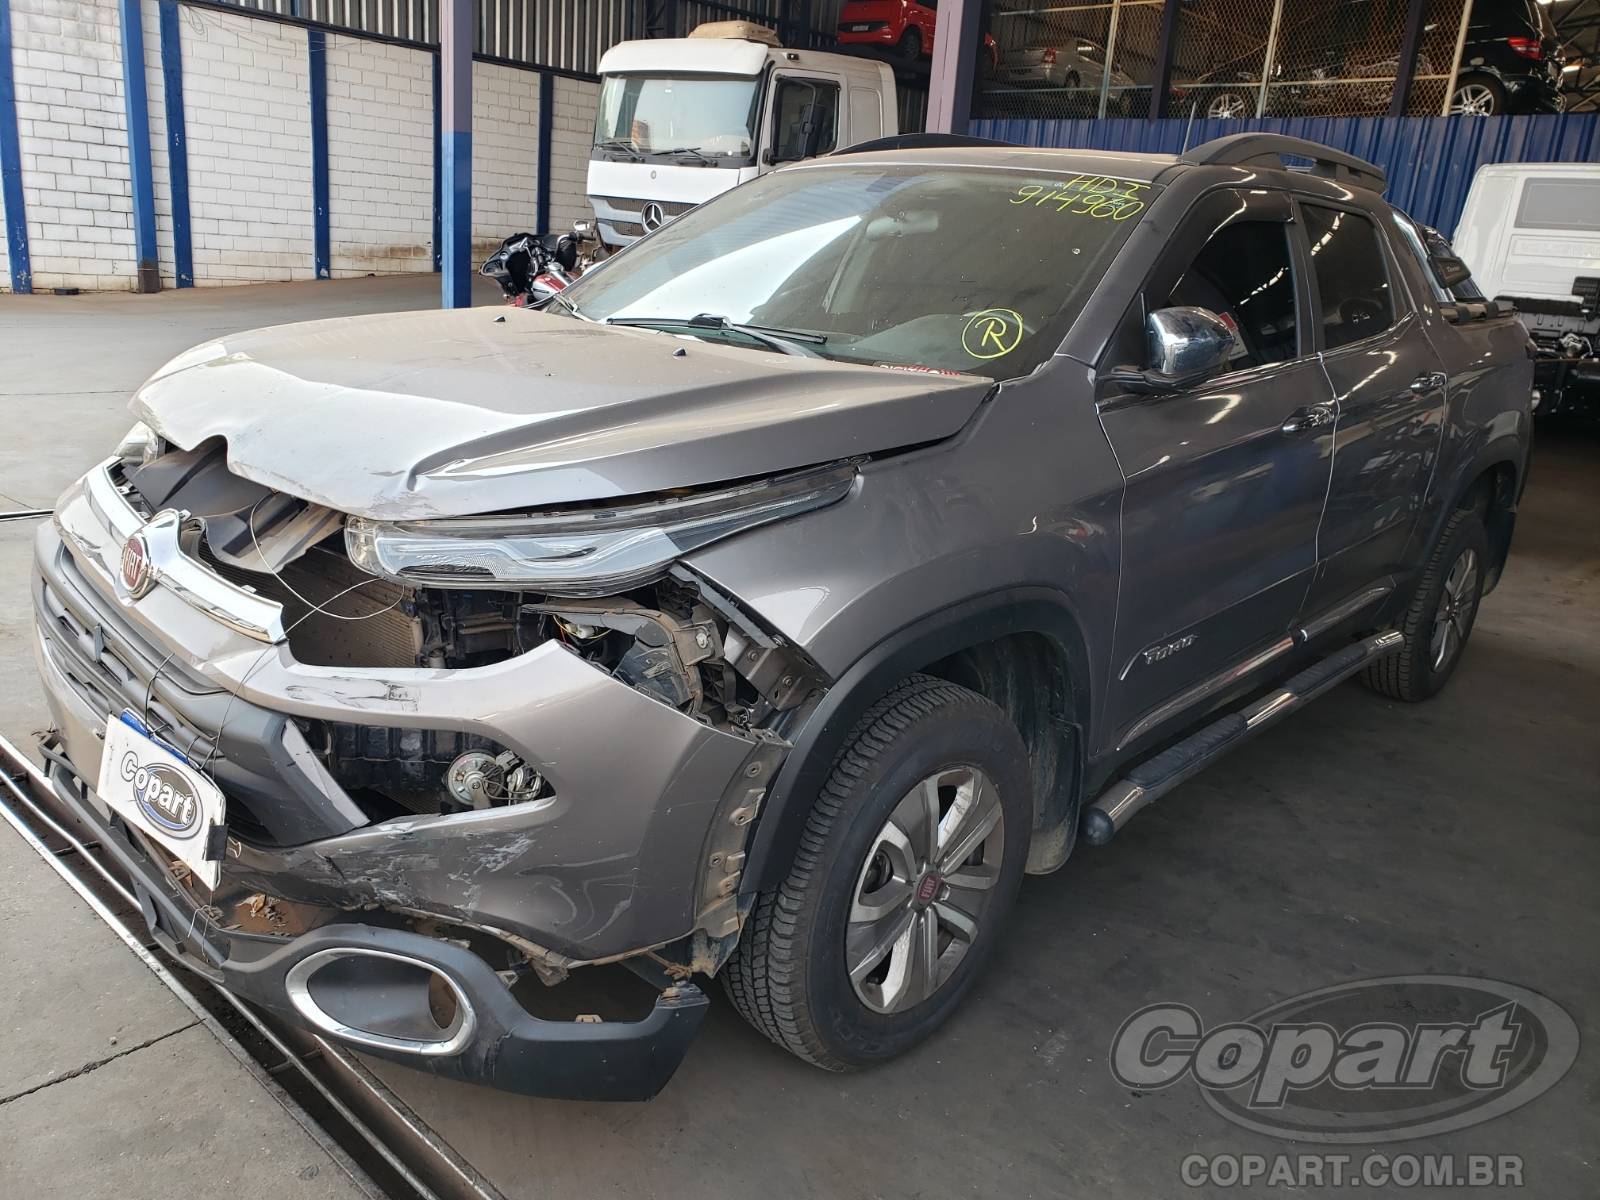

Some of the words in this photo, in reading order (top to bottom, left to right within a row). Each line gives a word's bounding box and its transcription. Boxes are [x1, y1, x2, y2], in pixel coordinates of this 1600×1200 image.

[1009, 185, 1144, 220] 914960
[123, 545, 142, 581] FIAT
[120, 750, 196, 826] Copart
